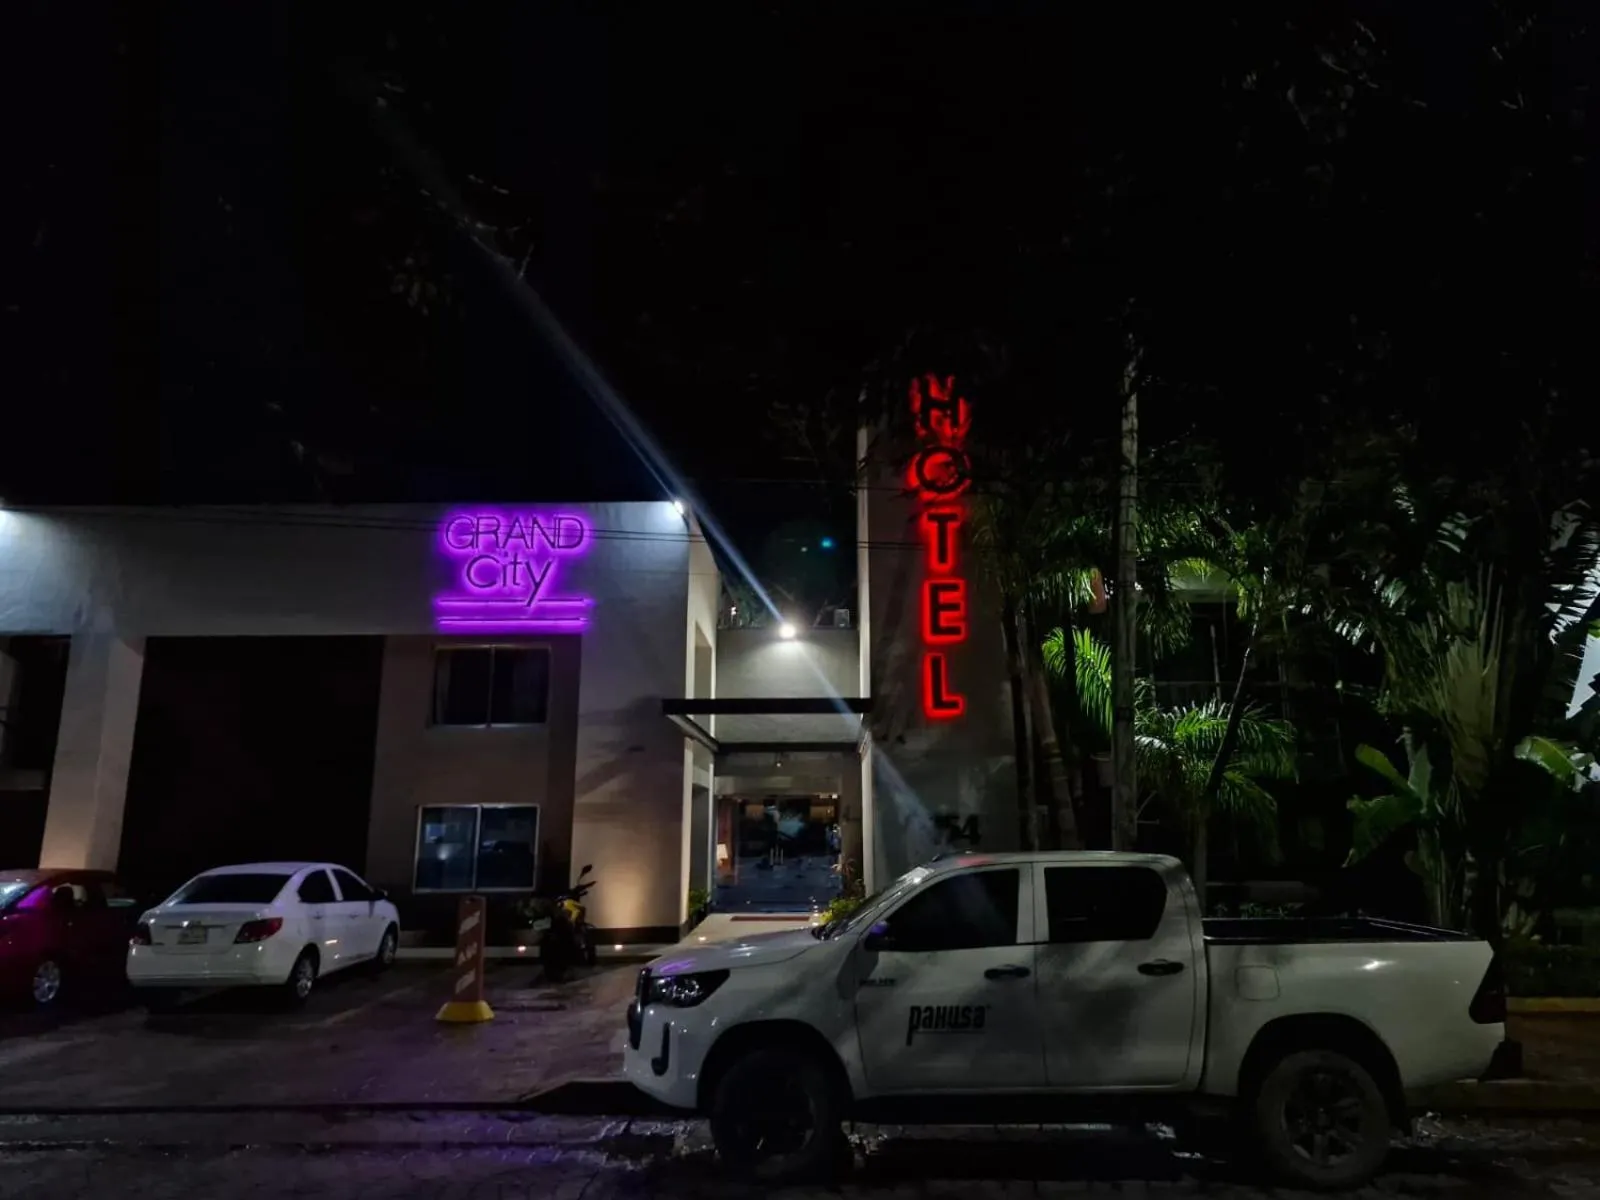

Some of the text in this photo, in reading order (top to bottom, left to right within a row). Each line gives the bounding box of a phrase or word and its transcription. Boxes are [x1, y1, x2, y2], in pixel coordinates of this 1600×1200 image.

[445, 515, 584, 550] GRAND
[909, 373, 969, 714] HOTEL
[466, 552, 553, 608] City
